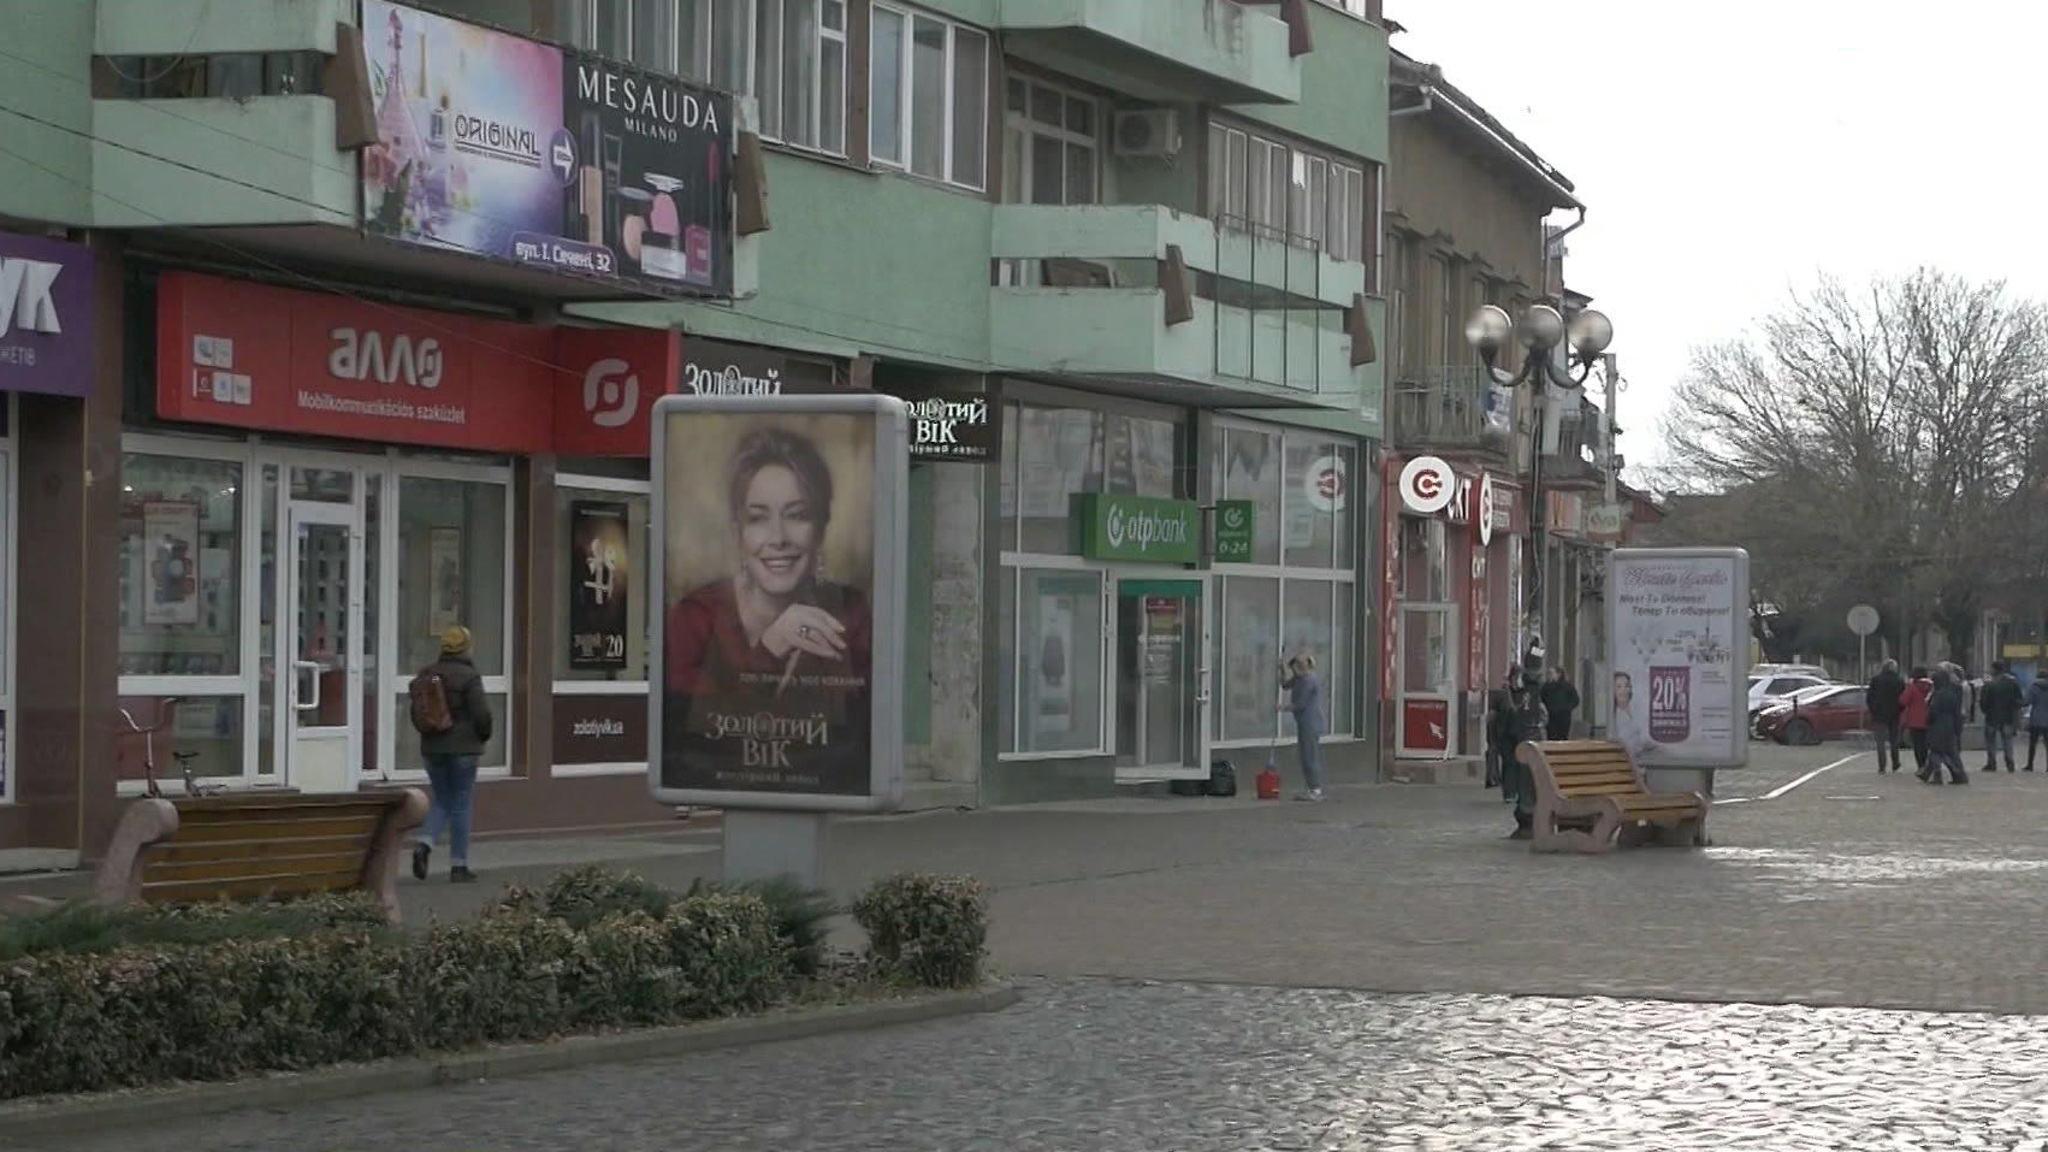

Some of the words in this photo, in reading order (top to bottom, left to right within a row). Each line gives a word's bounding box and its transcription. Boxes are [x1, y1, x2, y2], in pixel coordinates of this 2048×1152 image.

[577, 66, 720, 135] MESAUDA
[454, 114, 541, 156] ORIGINAL
[624, 117, 678, 143] MILANO
[604, 634, 624, 657] 20
